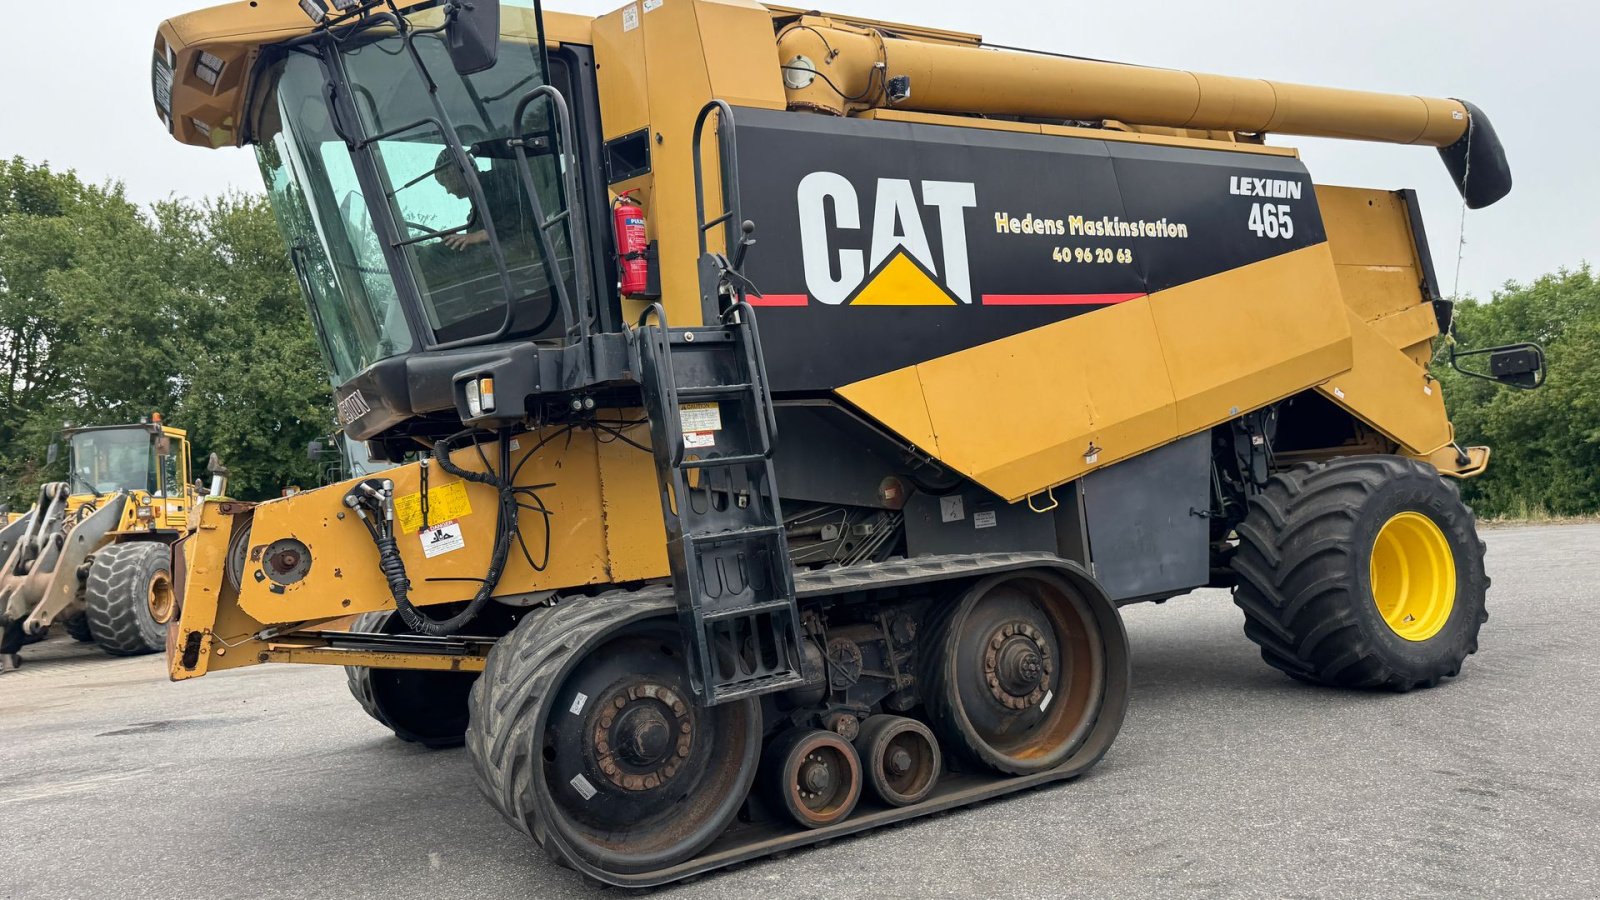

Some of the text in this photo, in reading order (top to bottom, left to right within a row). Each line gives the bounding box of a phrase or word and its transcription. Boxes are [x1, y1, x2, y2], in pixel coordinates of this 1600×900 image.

[1229, 176, 1302, 199] LEXION
[995, 212, 1188, 238] Hedens Maskinstation
[1248, 203, 1294, 239] 465
[797, 171, 977, 305] CAT
[1052, 247, 1133, 264] 40 96 20 63
